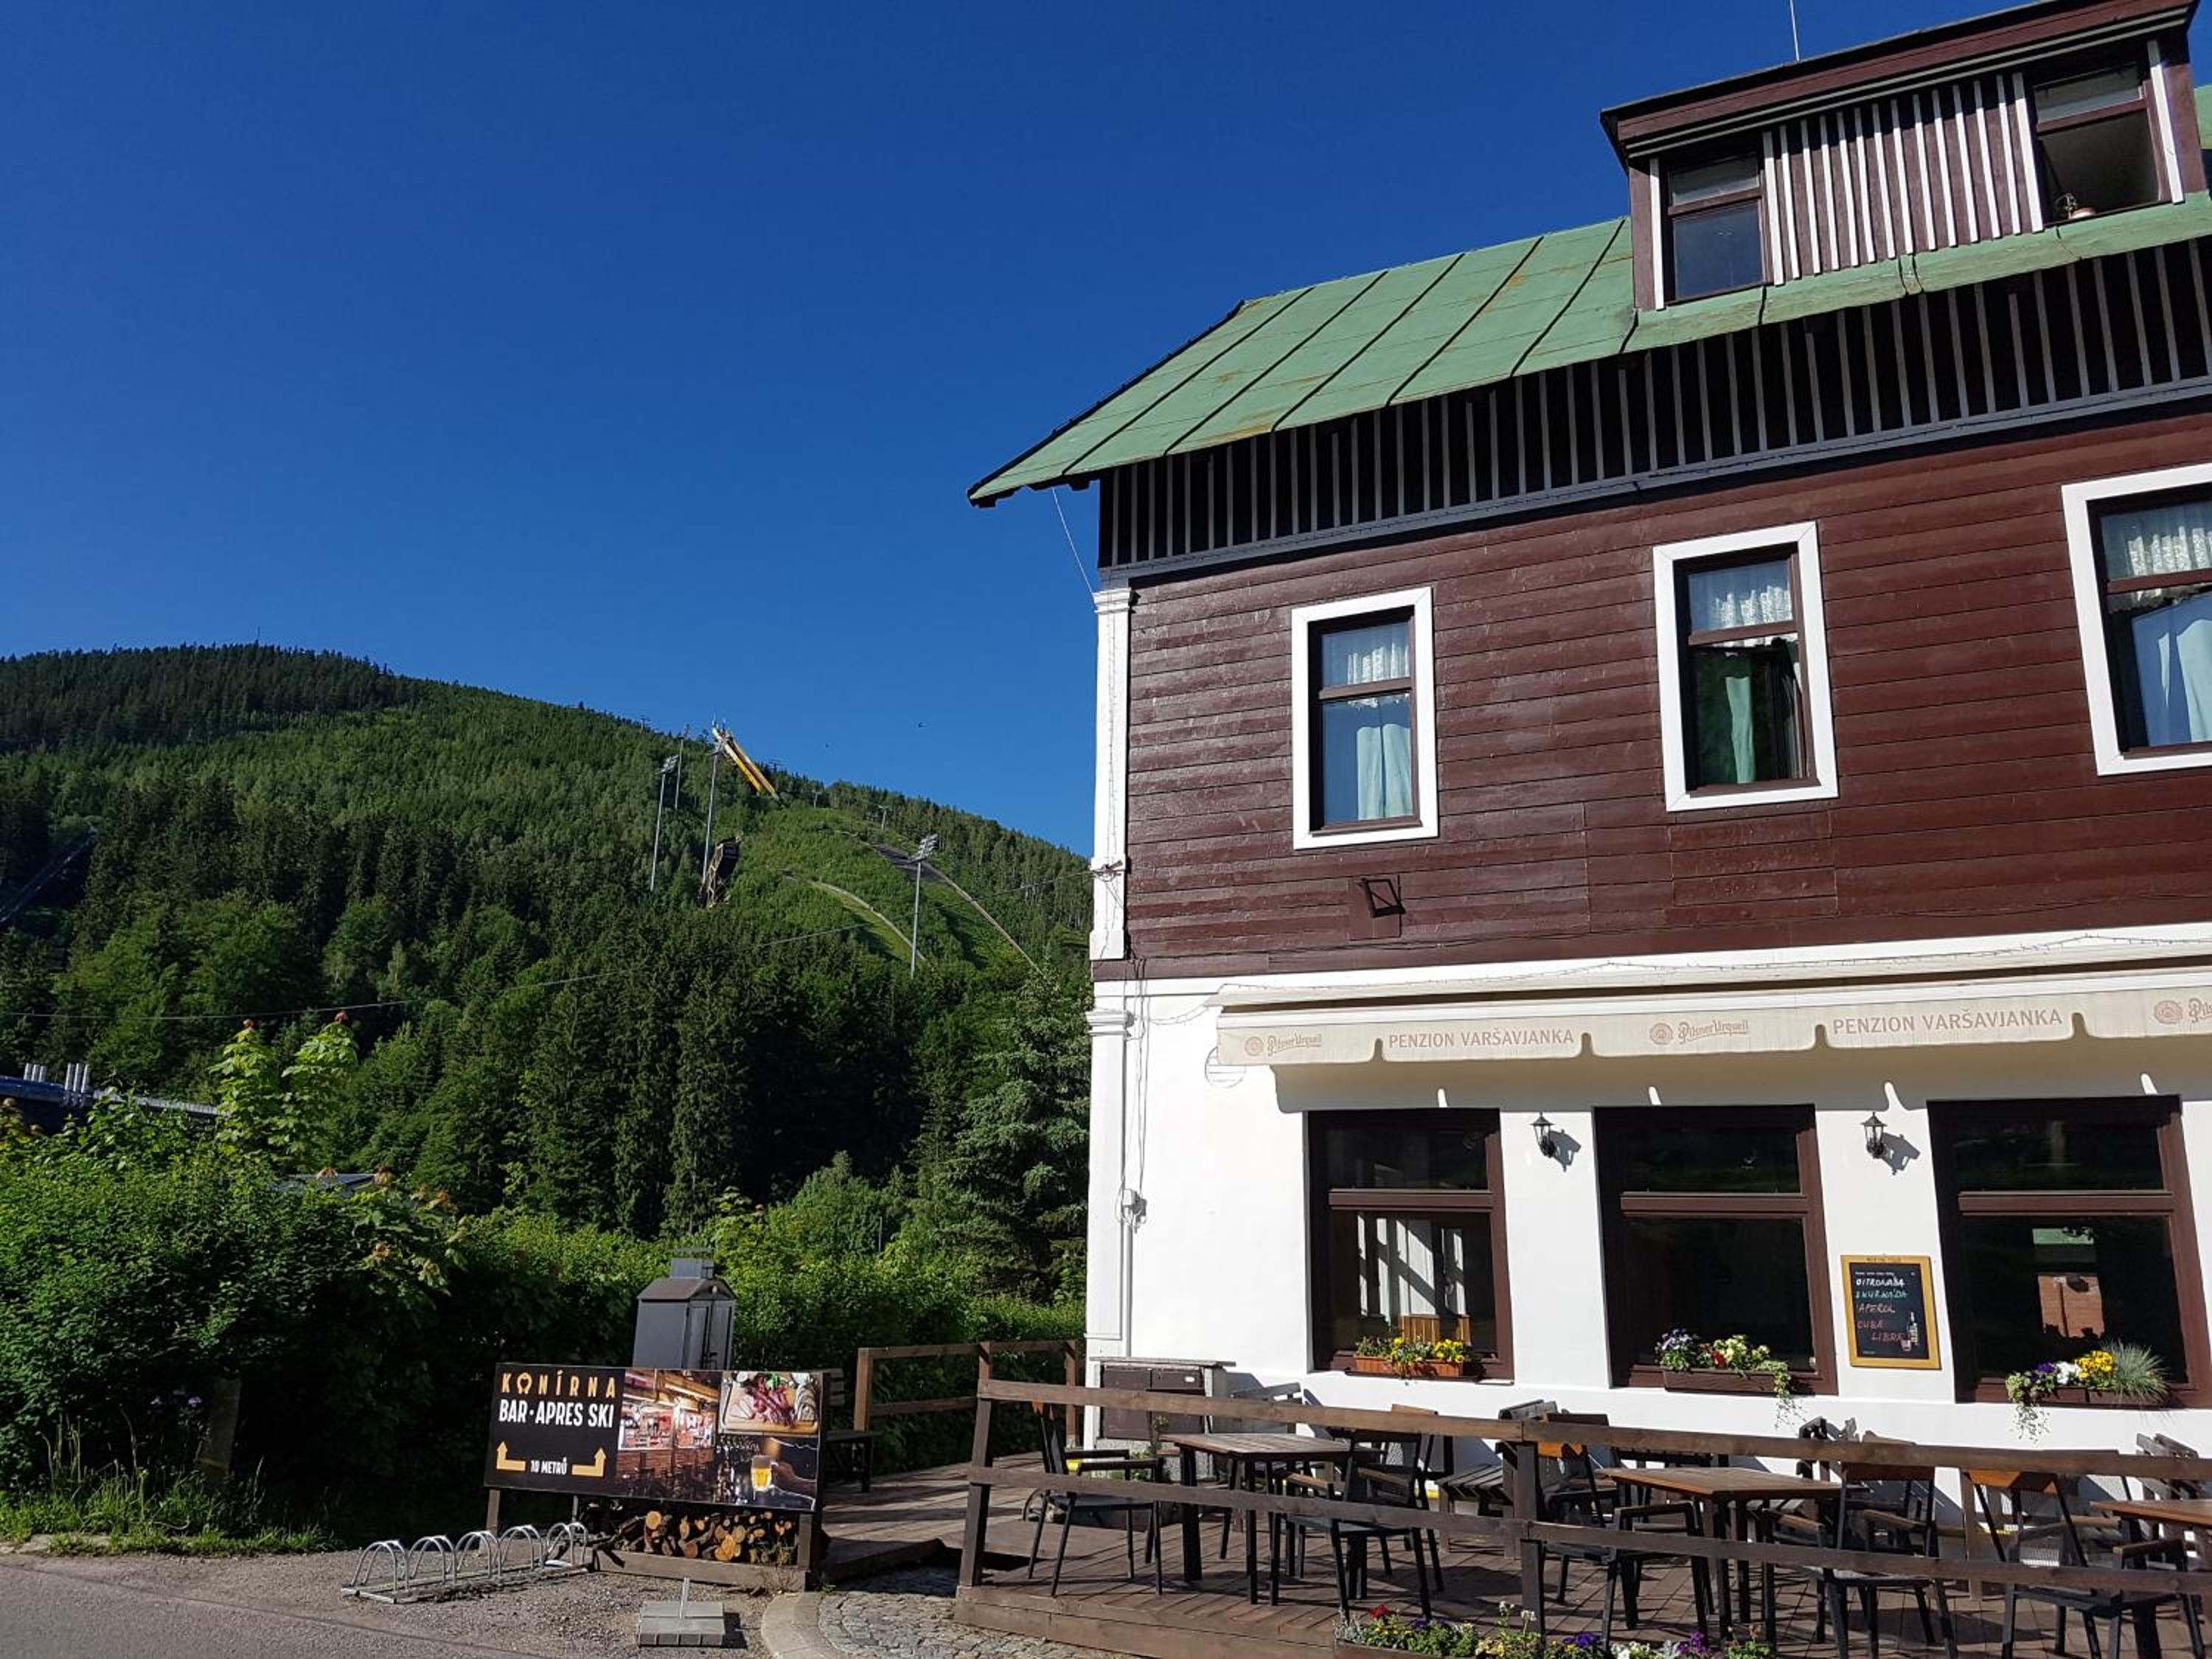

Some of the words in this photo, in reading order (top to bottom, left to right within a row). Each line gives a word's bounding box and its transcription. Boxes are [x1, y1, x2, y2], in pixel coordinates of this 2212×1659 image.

[1833, 1016, 1915, 1034] PENZION
[1921, 1008, 2063, 1031] VARŠAVJANKA
[1389, 1033, 1454, 1048] PENZION
[1461, 1027, 1574, 1046] VARŠAVJANKA
[501, 1369, 616, 1399] KONÍRNA
[588, 1403, 614, 1428] SKI
